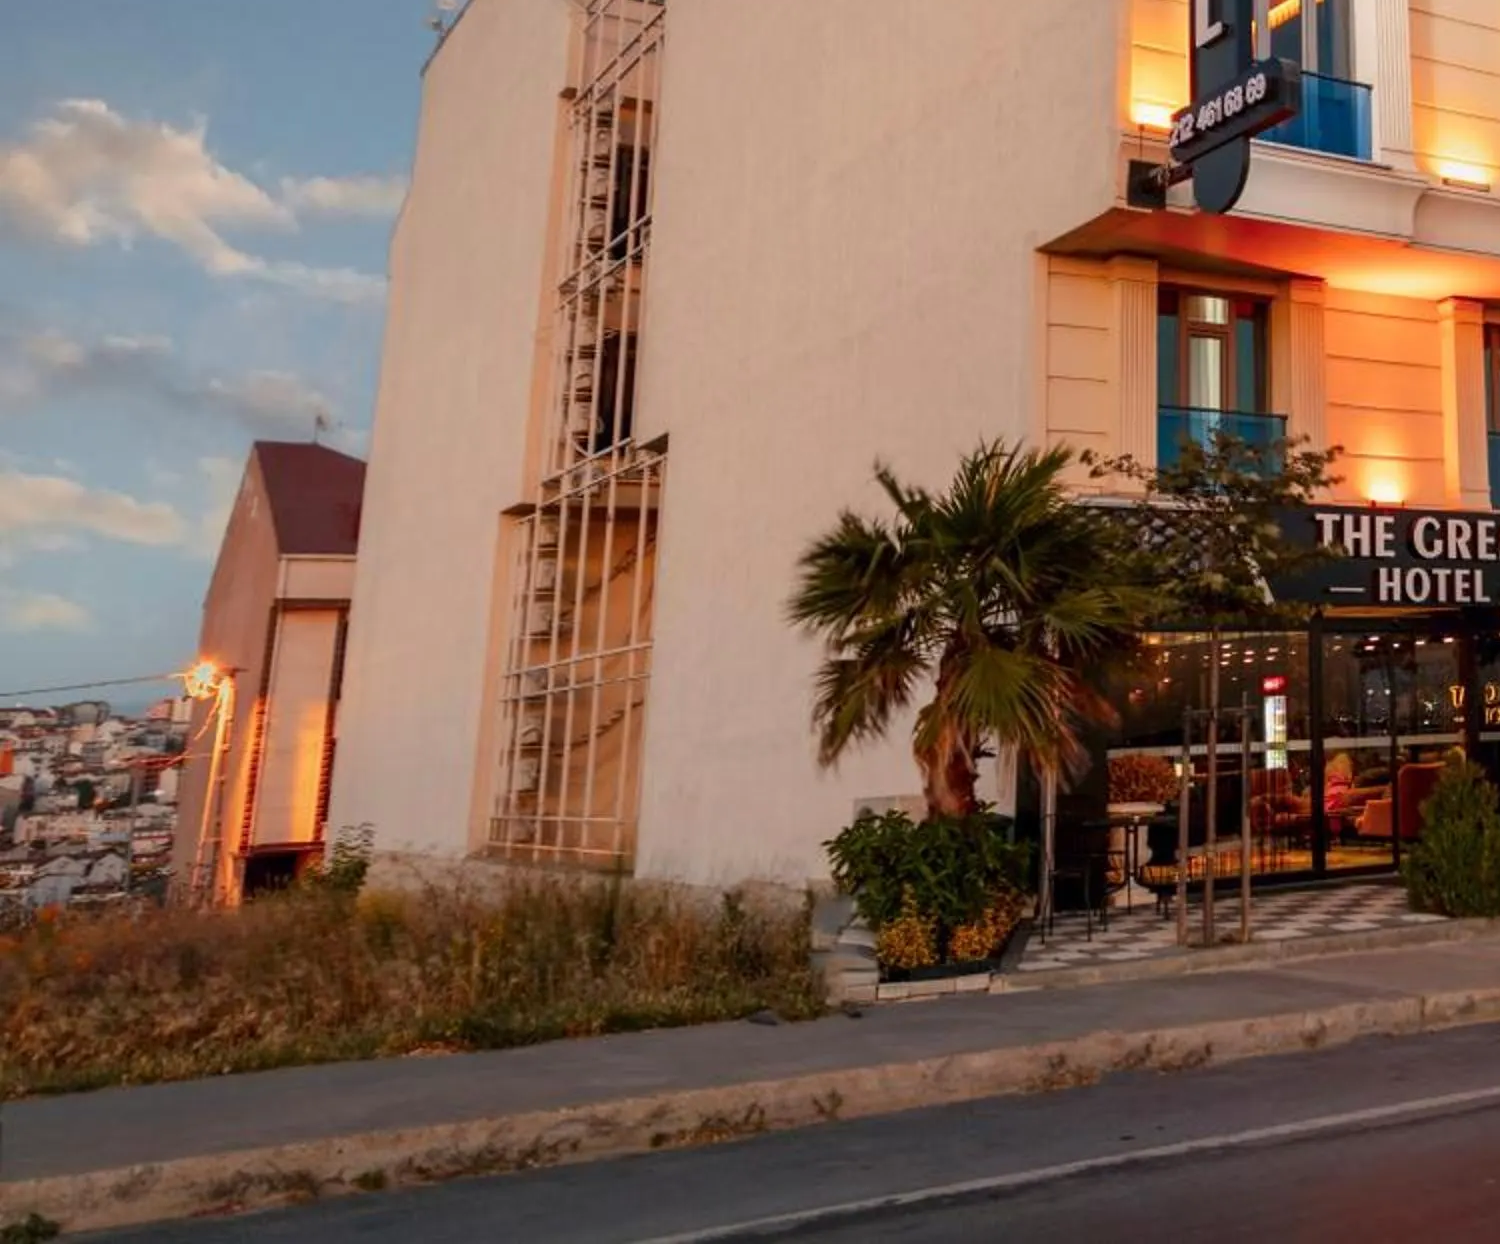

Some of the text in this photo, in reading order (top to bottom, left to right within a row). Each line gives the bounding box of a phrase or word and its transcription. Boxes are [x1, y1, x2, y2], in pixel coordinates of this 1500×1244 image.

[1196, 95, 1222, 131] 461
[1245, 72, 1267, 104] 69
[1315, 513, 1396, 558] THE
[1378, 567, 1491, 604] HOTEL
